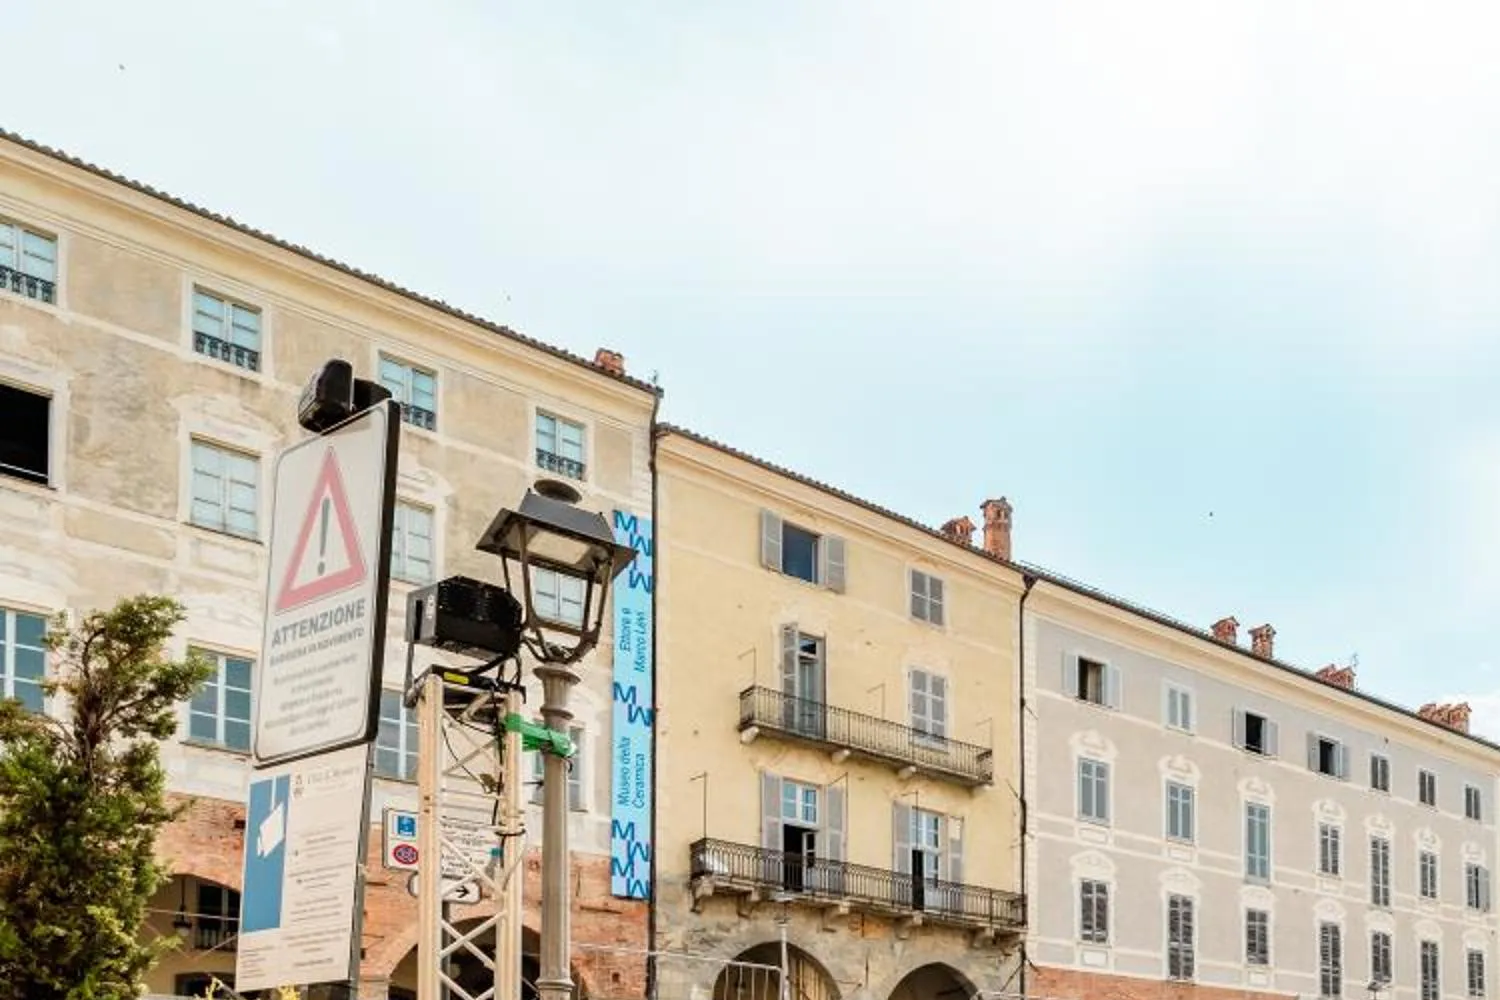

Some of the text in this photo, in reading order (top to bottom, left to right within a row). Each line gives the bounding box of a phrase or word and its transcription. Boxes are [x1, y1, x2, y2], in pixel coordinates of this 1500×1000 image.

[271, 598, 366, 648] ATTENZIONE
[633, 638, 646, 673] Marco
[618, 767, 631, 807] Museo
[632, 753, 645, 809] Ceramica
